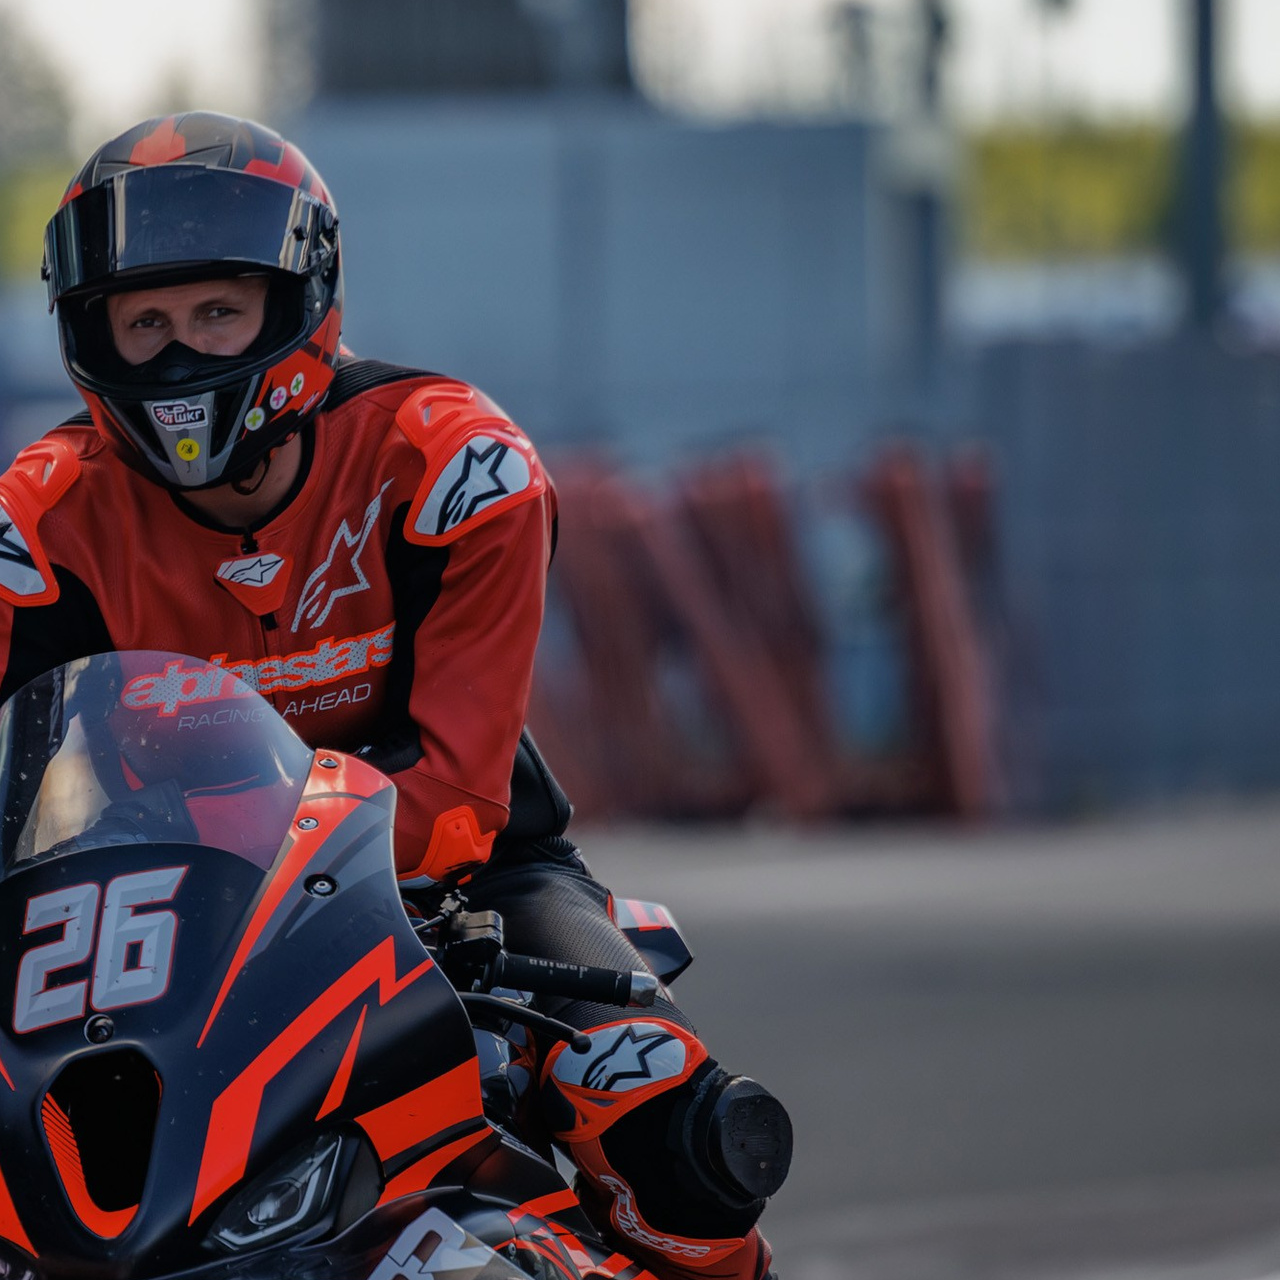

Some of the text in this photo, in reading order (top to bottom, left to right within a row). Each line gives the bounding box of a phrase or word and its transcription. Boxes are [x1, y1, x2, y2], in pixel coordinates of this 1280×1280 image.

[122, 621, 397, 715] alpinestars
[176, 683, 372, 731] RACING AHEAD
[13, 865, 190, 1034] 26
